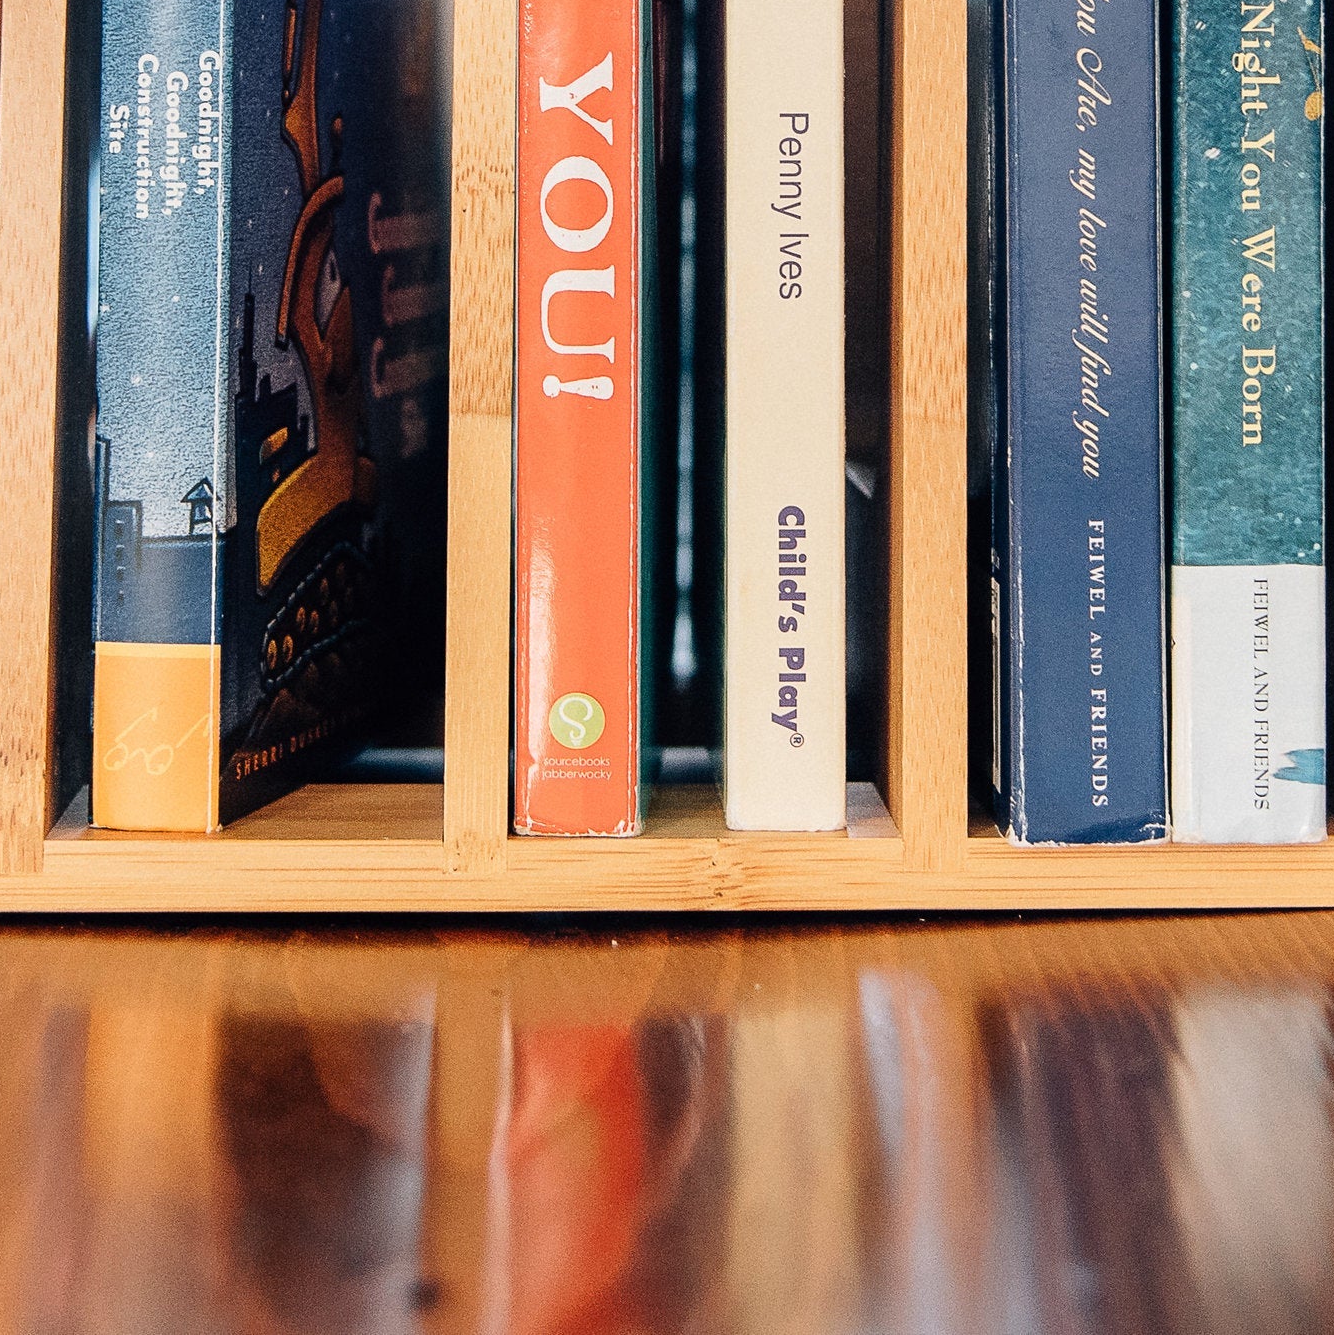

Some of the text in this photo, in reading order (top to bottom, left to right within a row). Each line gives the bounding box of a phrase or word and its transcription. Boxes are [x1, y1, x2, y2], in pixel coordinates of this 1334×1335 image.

[1076, 46, 1113, 132] Are,
[1231, 1, 1282, 116] Night
[109, 104, 130, 155] Site
[135, 53, 160, 220] Construction
[161, 70, 190, 216] Goodnight,
[193, 50, 221, 195] Goodnight,
[1240, 128, 1277, 211] You
[771, 112, 809, 300] Penny Ives
[1067, 148, 1097, 200] my
[538, 51, 616, 401] YOU!
[1078, 208, 1107, 272] love
[1079, 278, 1110, 342] will
[1240, 226, 1277, 332] Were
[1071, 327, 1113, 418] find
[1241, 345, 1278, 447] Born
[1071, 409, 1100, 480] you
[777, 505, 805, 633] Child's
[1087, 519, 1109, 807] FEIWEL AND FRIENDS
[1252, 578, 1271, 810] FEIWEL AND FRIENDS
[542, 768, 612, 782] jabberwocky
[543, 756, 611, 767] sourcebooks
